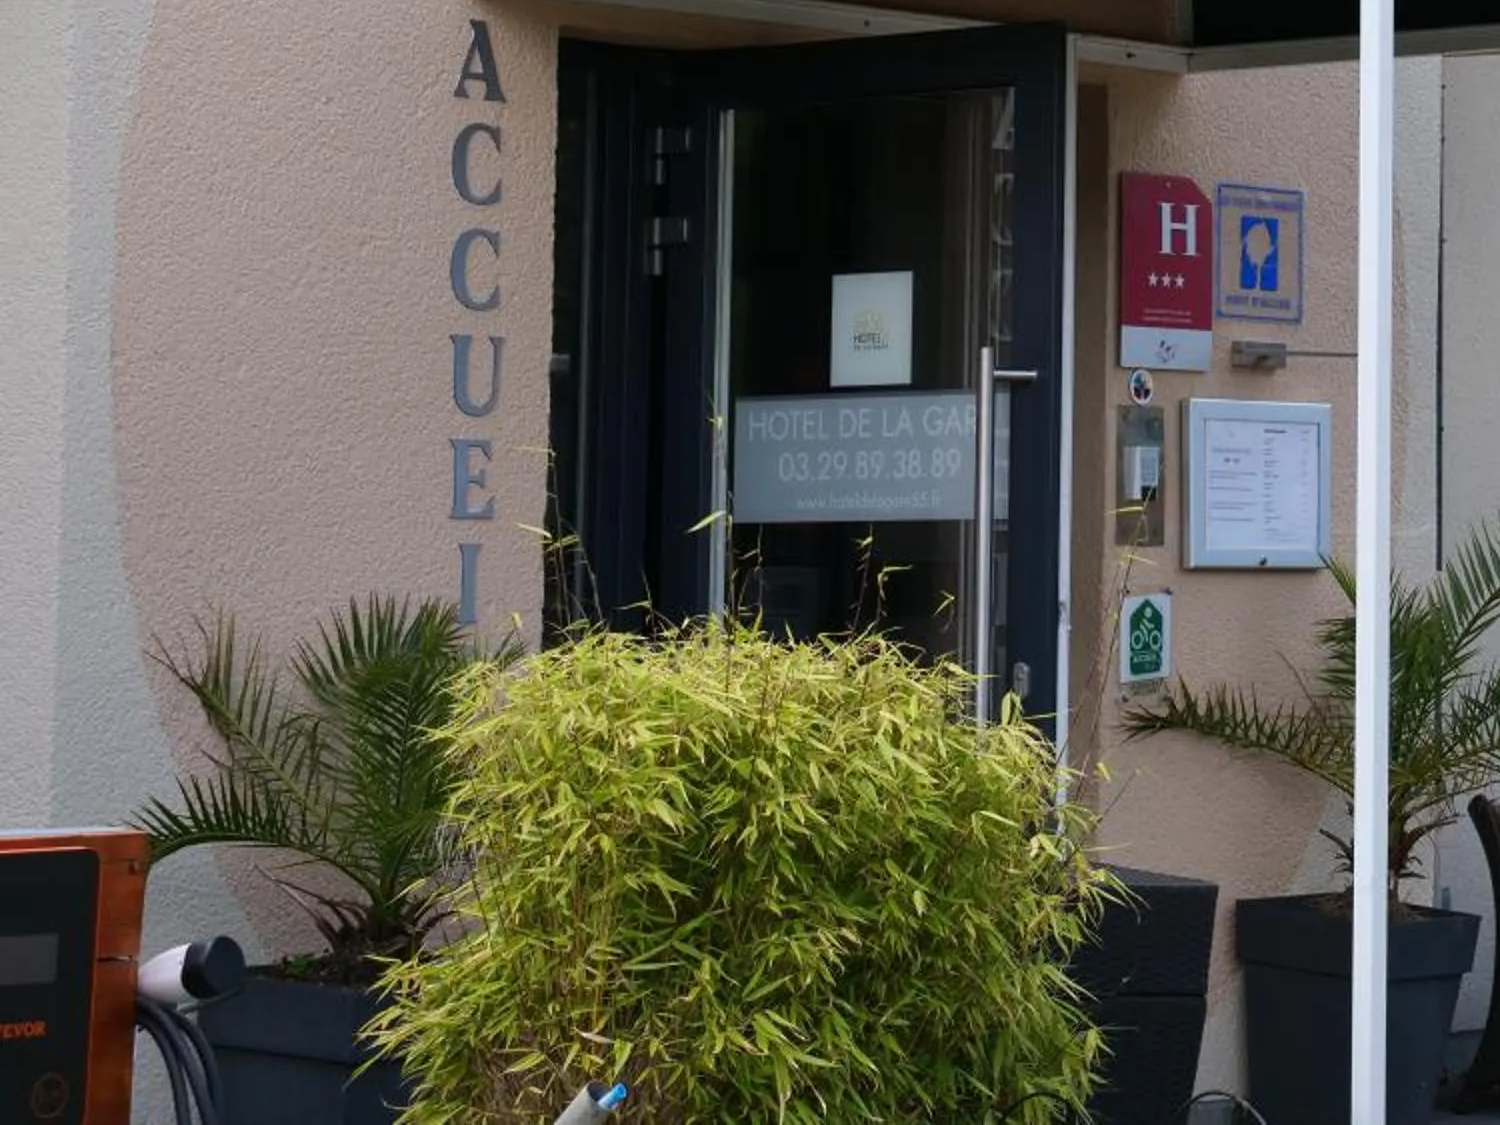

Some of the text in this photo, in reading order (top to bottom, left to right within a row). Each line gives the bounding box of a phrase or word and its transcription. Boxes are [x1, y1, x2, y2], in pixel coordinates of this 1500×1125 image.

[1158, 202, 1200, 257] H
[449, 18, 507, 628] ACCUEI
[748, 403, 977, 442] HOTEL DE LA GAR
[778, 447, 962, 482] 03.29.89.38.89
[0, 1020, 46, 1039] EVOR
